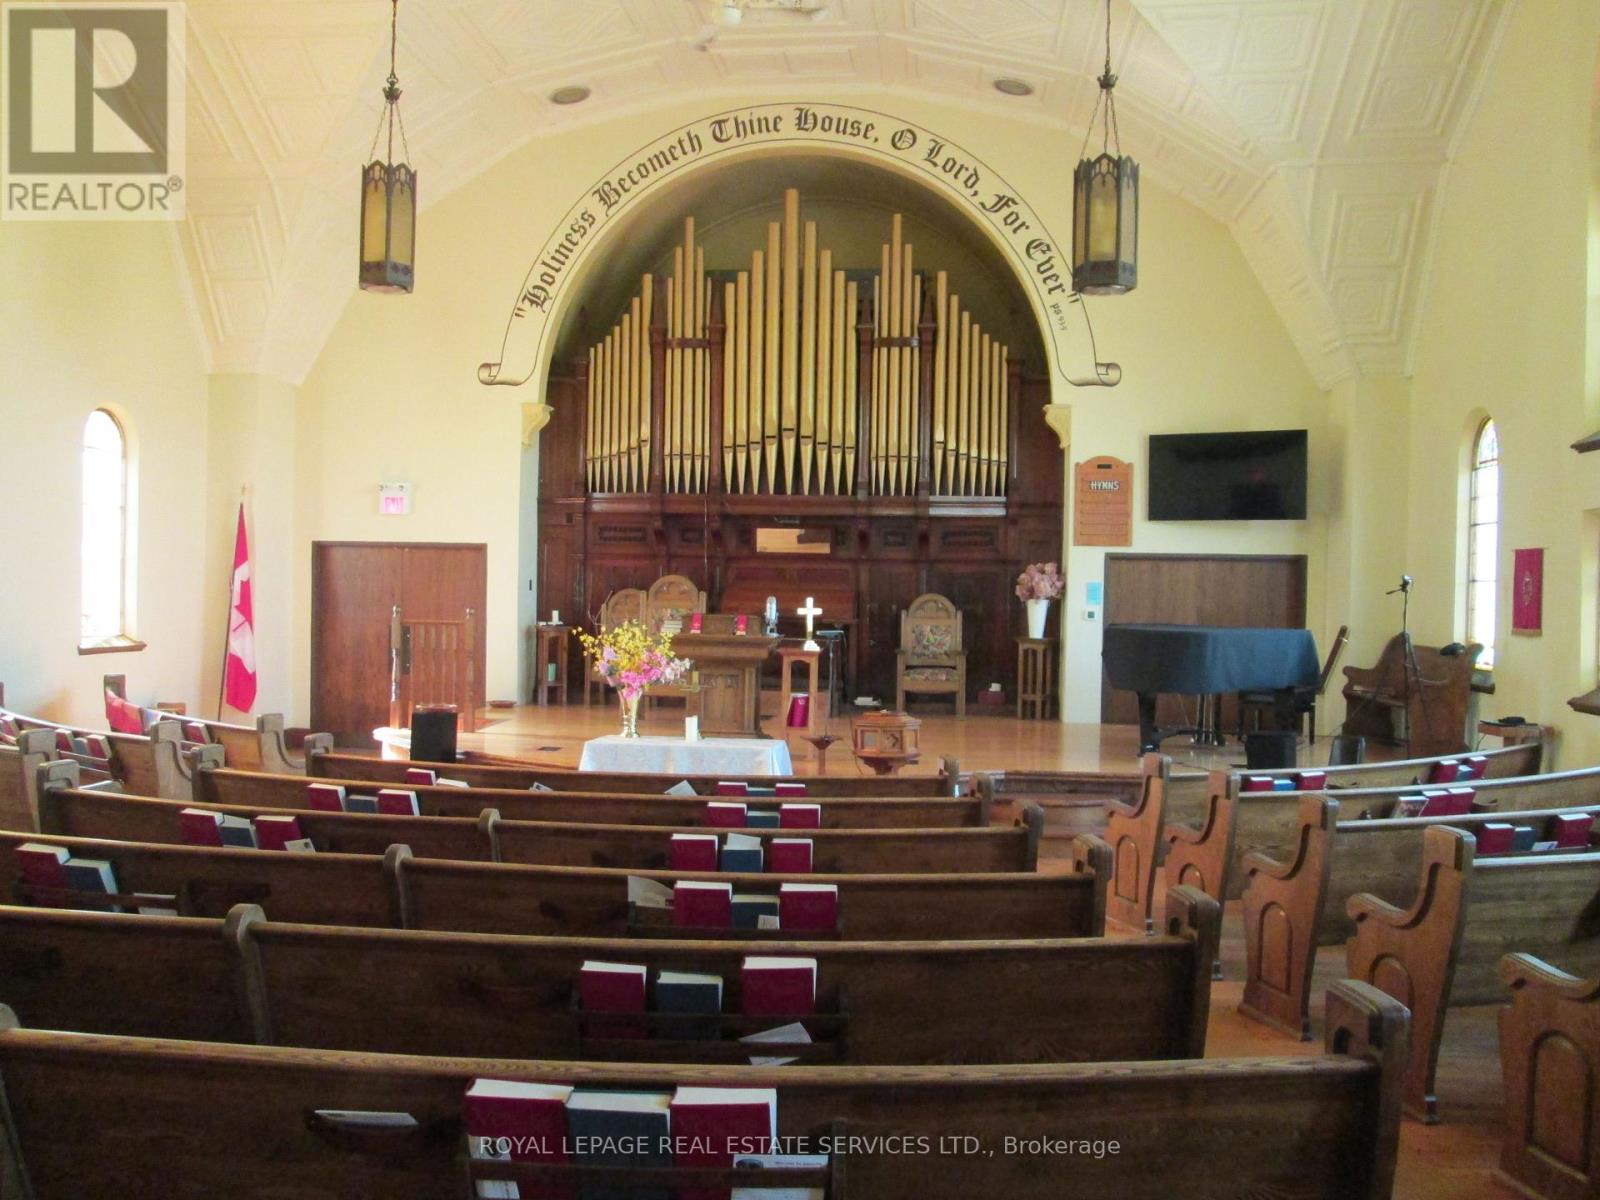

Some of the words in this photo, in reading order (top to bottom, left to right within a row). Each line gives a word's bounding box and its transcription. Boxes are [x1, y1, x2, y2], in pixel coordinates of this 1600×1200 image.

[591, 129, 703, 218] Becometh
[710, 111, 783, 144] Thine
[890, 127, 918, 151] O
[980, 192, 1030, 235] For
[1089, 479, 1121, 491] HYMNS
